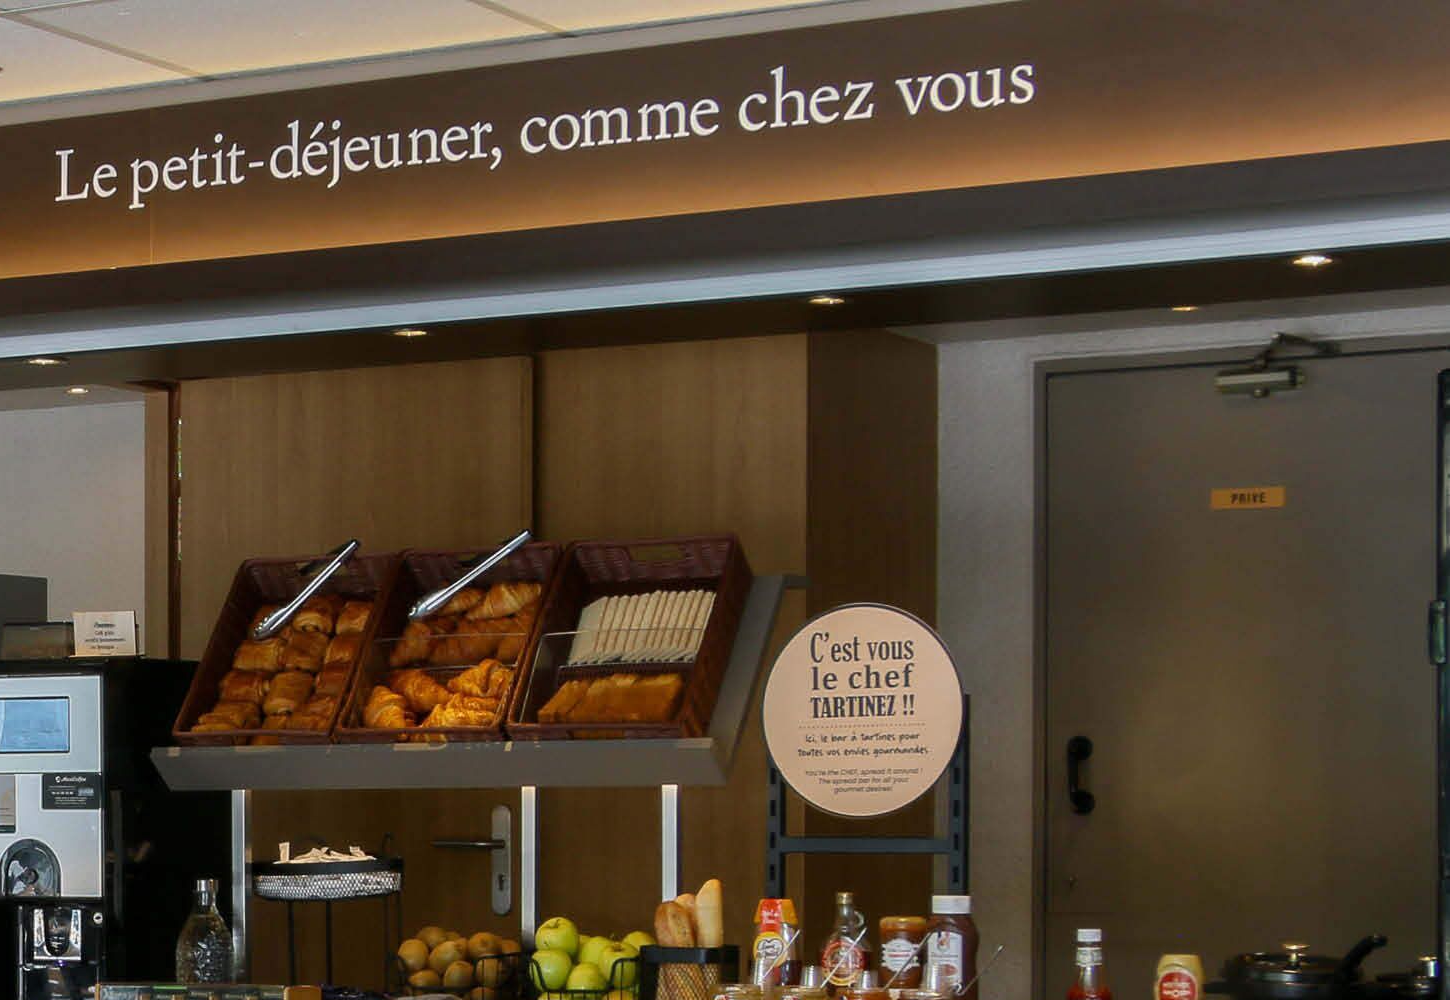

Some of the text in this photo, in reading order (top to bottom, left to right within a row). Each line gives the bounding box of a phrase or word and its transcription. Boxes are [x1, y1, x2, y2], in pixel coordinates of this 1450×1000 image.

[55, 64, 1035, 210] Le petit-déjeuner, comme chez vous
[810, 631, 915, 663] C'est vous
[811, 662, 915, 690] le chef
[810, 693, 916, 718] TARTINEZ !!
[861, 732, 896, 742] tartines
[898, 732, 921, 743] pour
